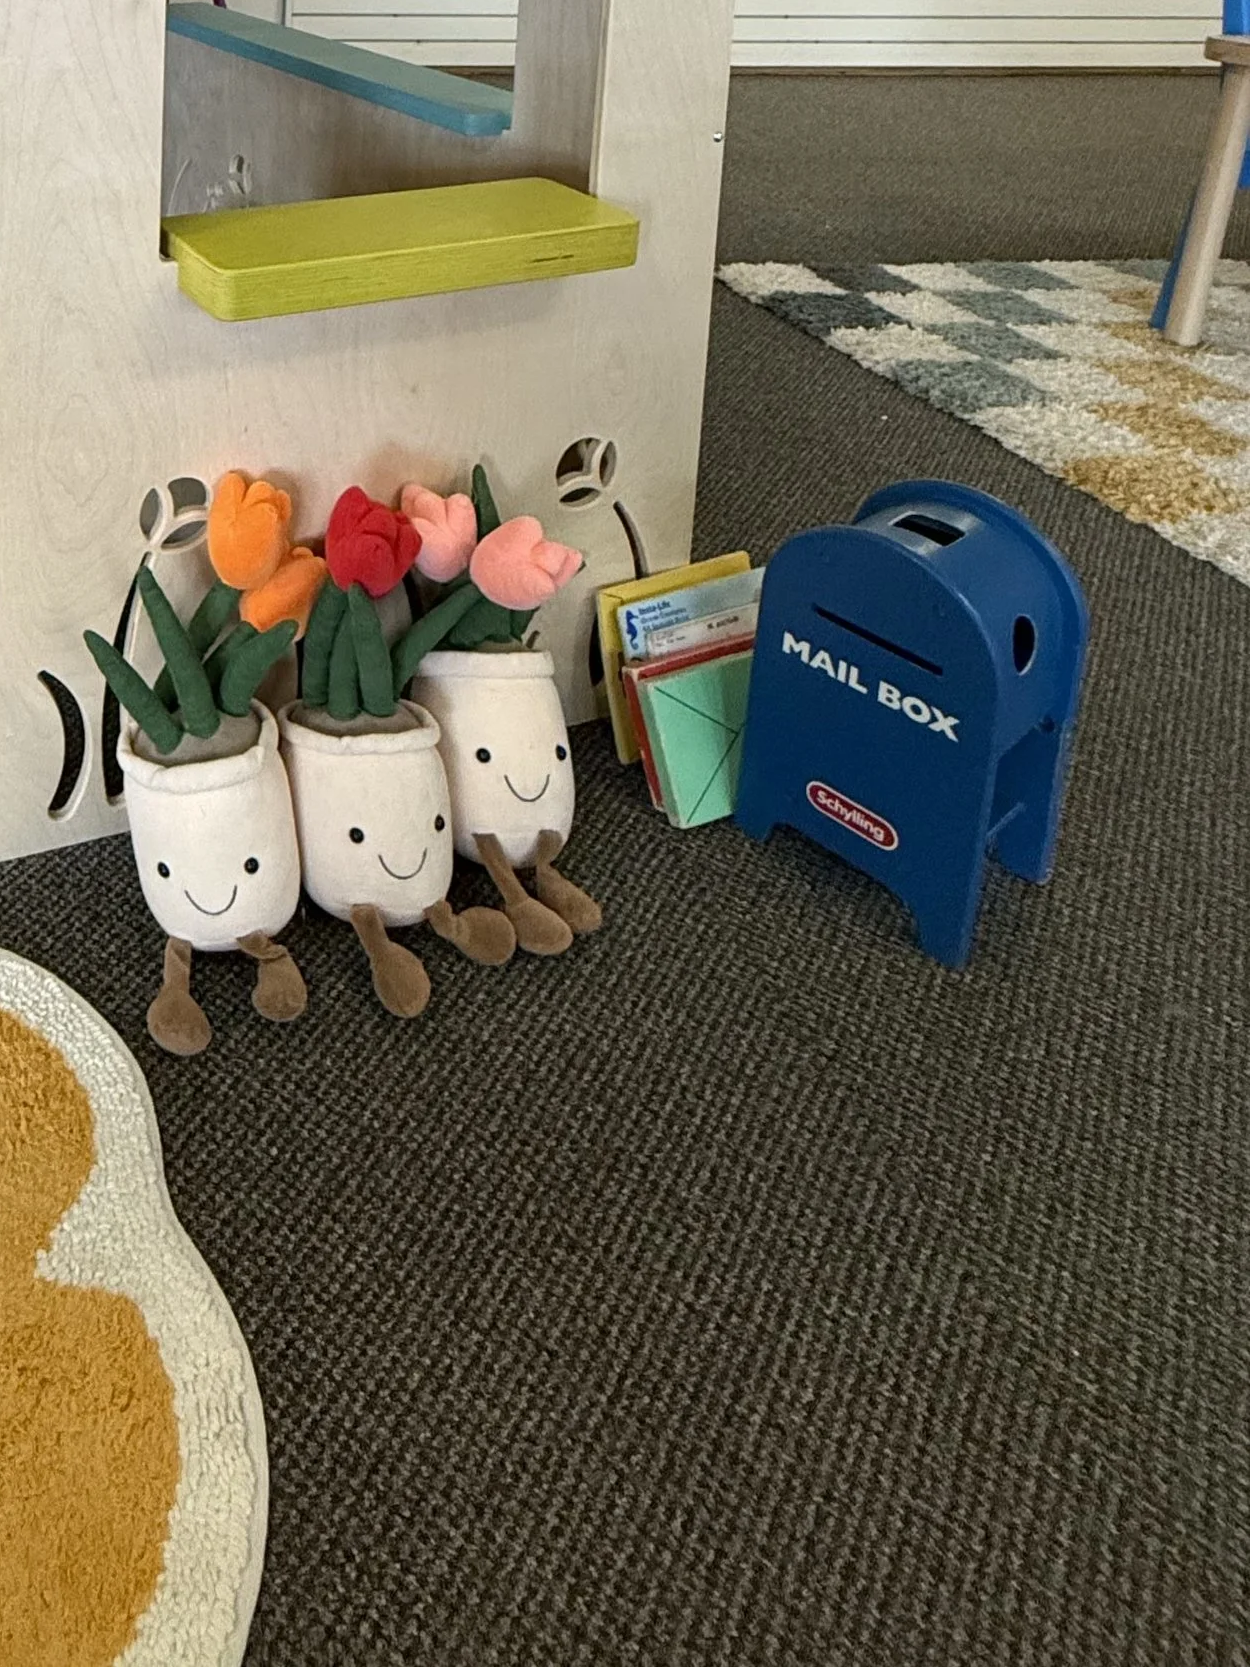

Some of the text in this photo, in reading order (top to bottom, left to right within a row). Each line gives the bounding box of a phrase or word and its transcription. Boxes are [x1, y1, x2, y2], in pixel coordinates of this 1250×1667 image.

[782, 630, 960, 743] MAIL BOX
[816, 789, 887, 842] Schylling
